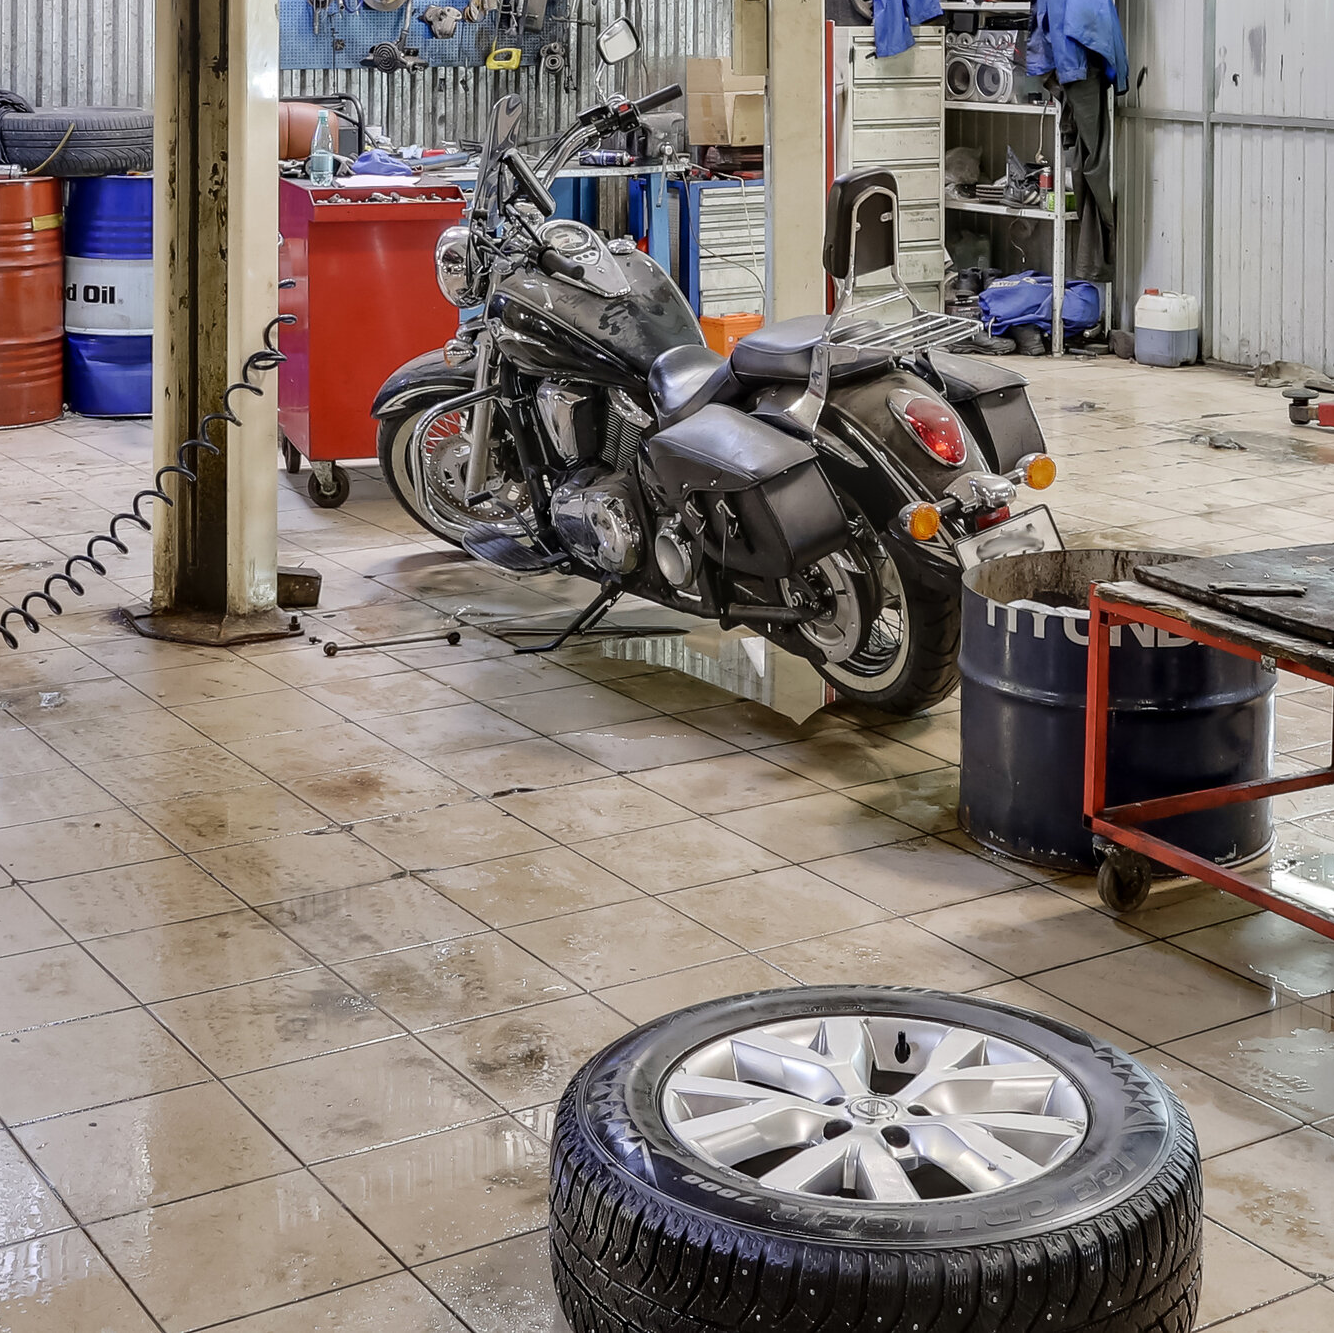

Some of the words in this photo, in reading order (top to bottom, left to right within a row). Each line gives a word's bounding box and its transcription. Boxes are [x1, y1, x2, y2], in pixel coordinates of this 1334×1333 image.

[83, 284, 116, 305] Oil
[986, 597, 1208, 649] HYUND
[682, 1173, 757, 1205] 7000
